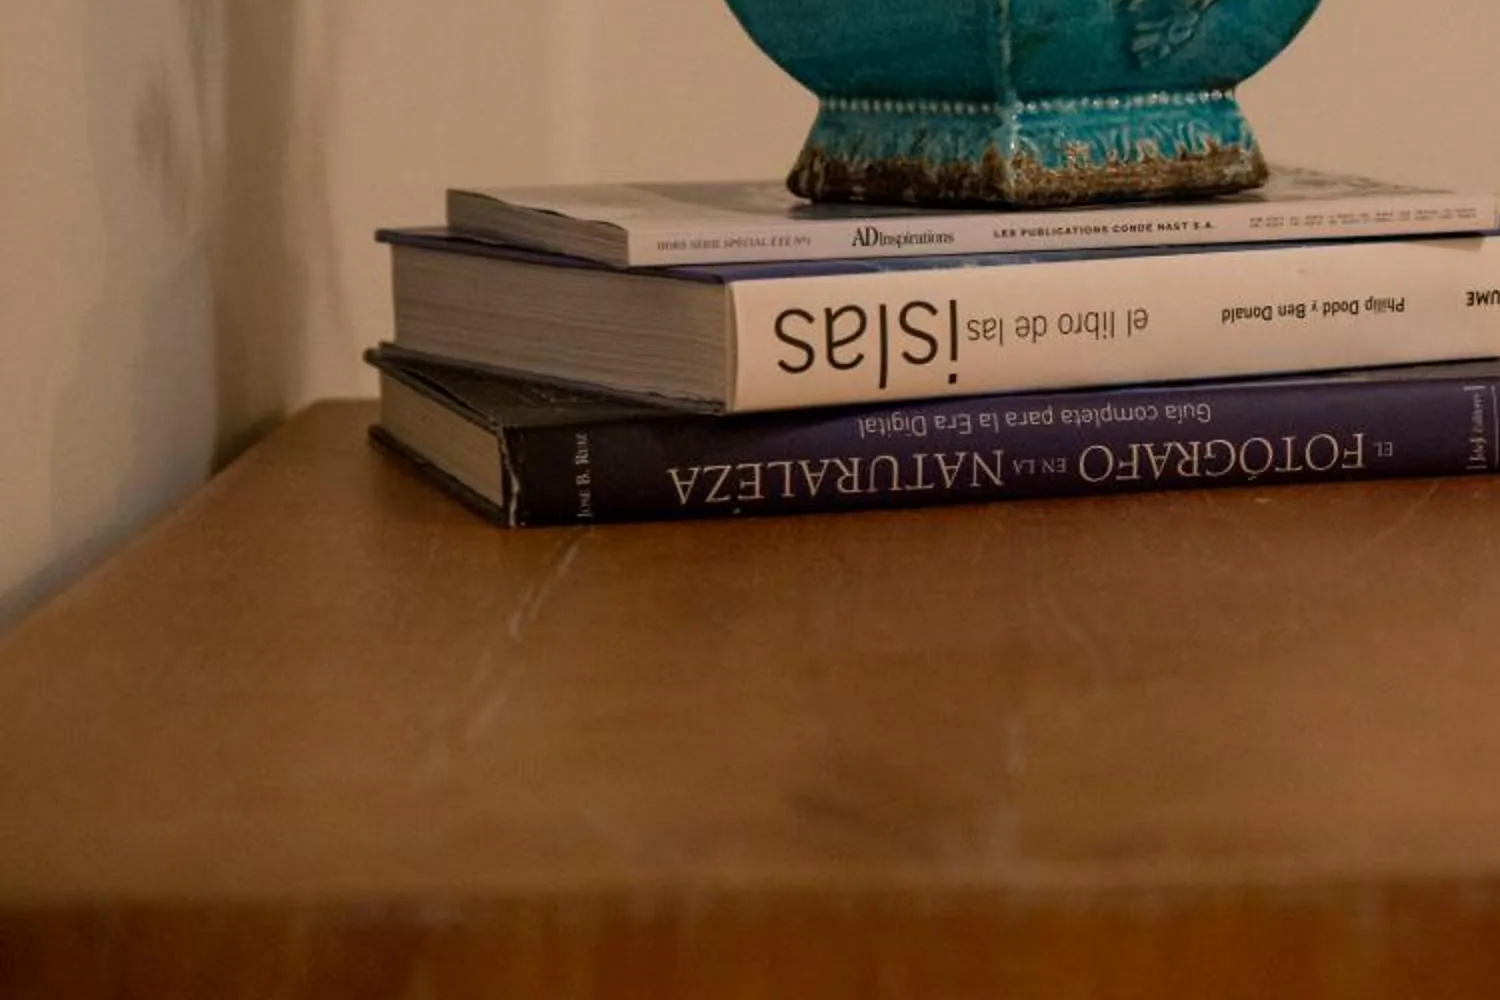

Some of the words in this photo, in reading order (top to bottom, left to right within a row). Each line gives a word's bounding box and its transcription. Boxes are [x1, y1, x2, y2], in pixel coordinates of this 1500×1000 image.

[993, 229, 1017, 239] LES
[1020, 225, 1109, 238] PUBLICATIONS
[1157, 221, 1188, 232] NAST
[1221, 304, 1273, 324] Donald
[1277, 302, 1306, 320] Ben
[1310, 303, 1319, 314] y
[1322, 300, 1359, 318] Dodd
[1364, 296, 1405, 314] Philip
[967, 316, 1004, 345] las
[1015, 313, 1047, 343] de
[1058, 309, 1115, 340] libro
[1127, 306, 1149, 337] el
[774, 298, 958, 389] islas
[980, 412, 999, 434] la
[1005, 406, 1053, 427] para
[1061, 404, 1159, 427] completa
[1165, 402, 1211, 424] Guía
[857, 412, 928, 439] Digital
[933, 414, 973, 436] Era
[1079, 431, 1367, 484] FOTÓGRAFO
[1375, 440, 1394, 457] EL
[667, 448, 1005, 505] NATURALEZA
[1011, 458, 1035, 476] LA
[1042, 457, 1067, 474] EN
[575, 469, 592, 486] B.
